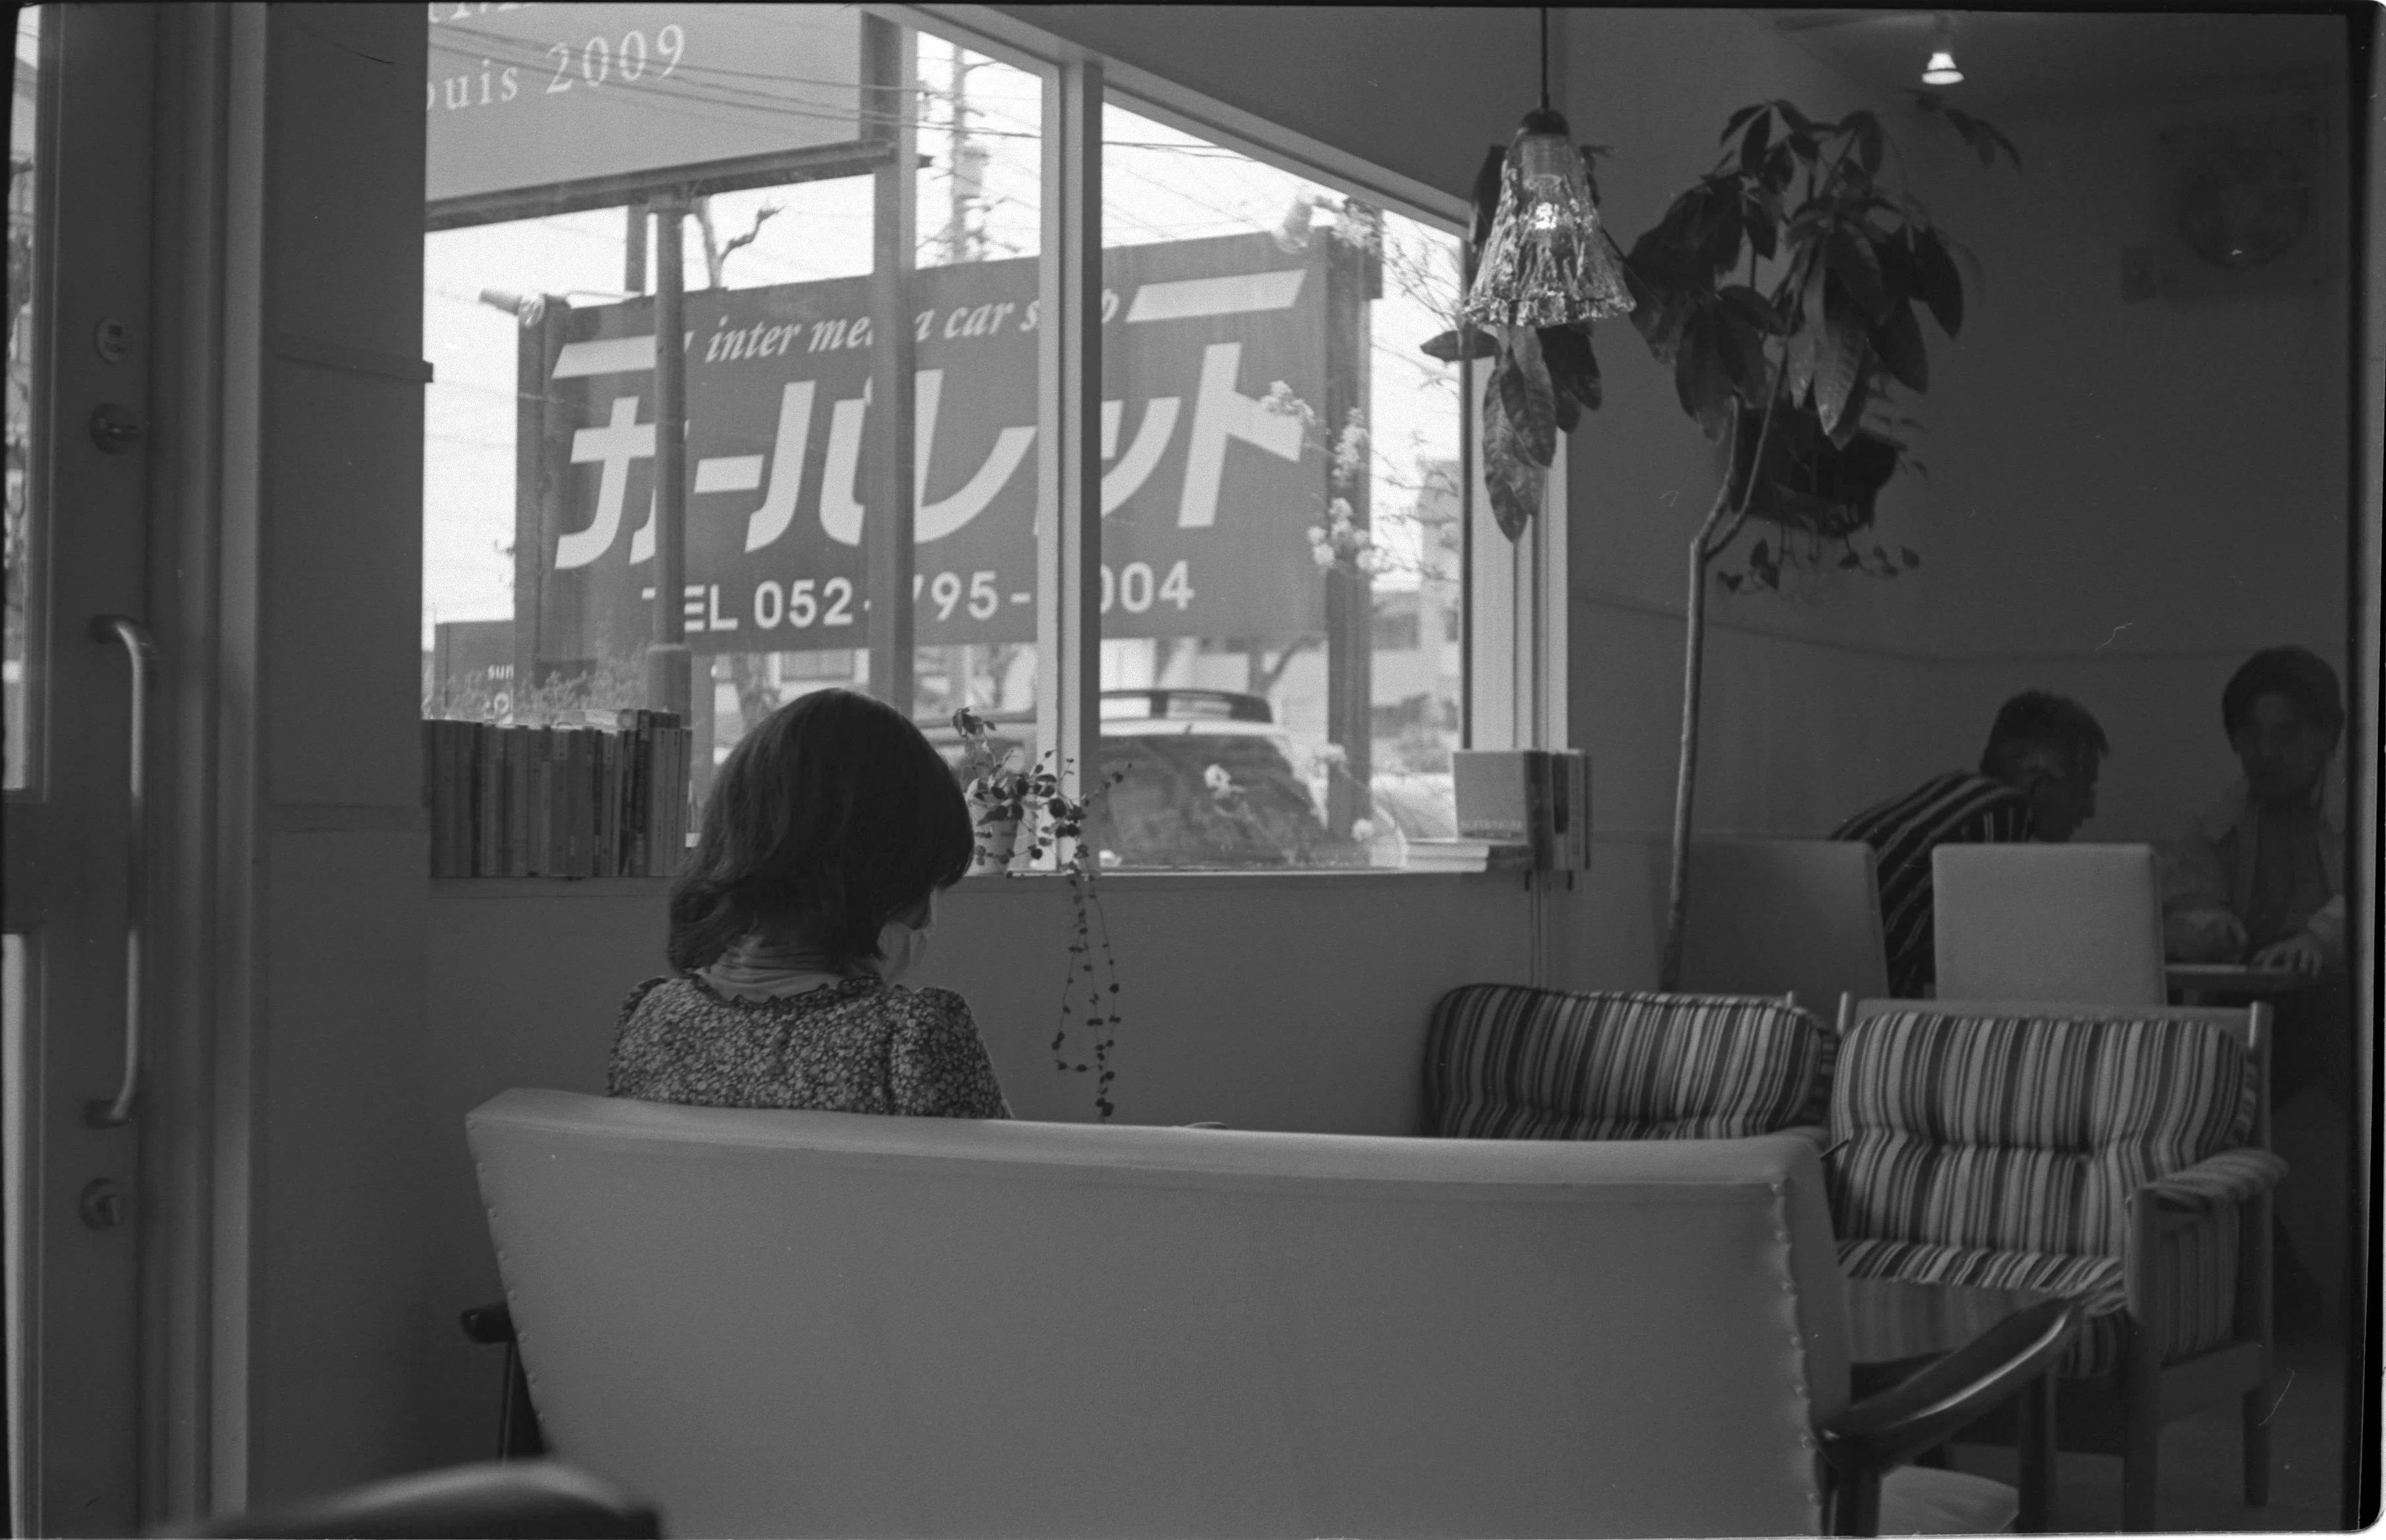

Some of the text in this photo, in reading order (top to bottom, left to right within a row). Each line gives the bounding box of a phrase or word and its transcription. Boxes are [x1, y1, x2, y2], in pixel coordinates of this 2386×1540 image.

[546, 24, 685, 94] 2009
[704, 315, 802, 363] inter
[807, 309, 936, 353] mea
[943, 302, 1015, 339] car
